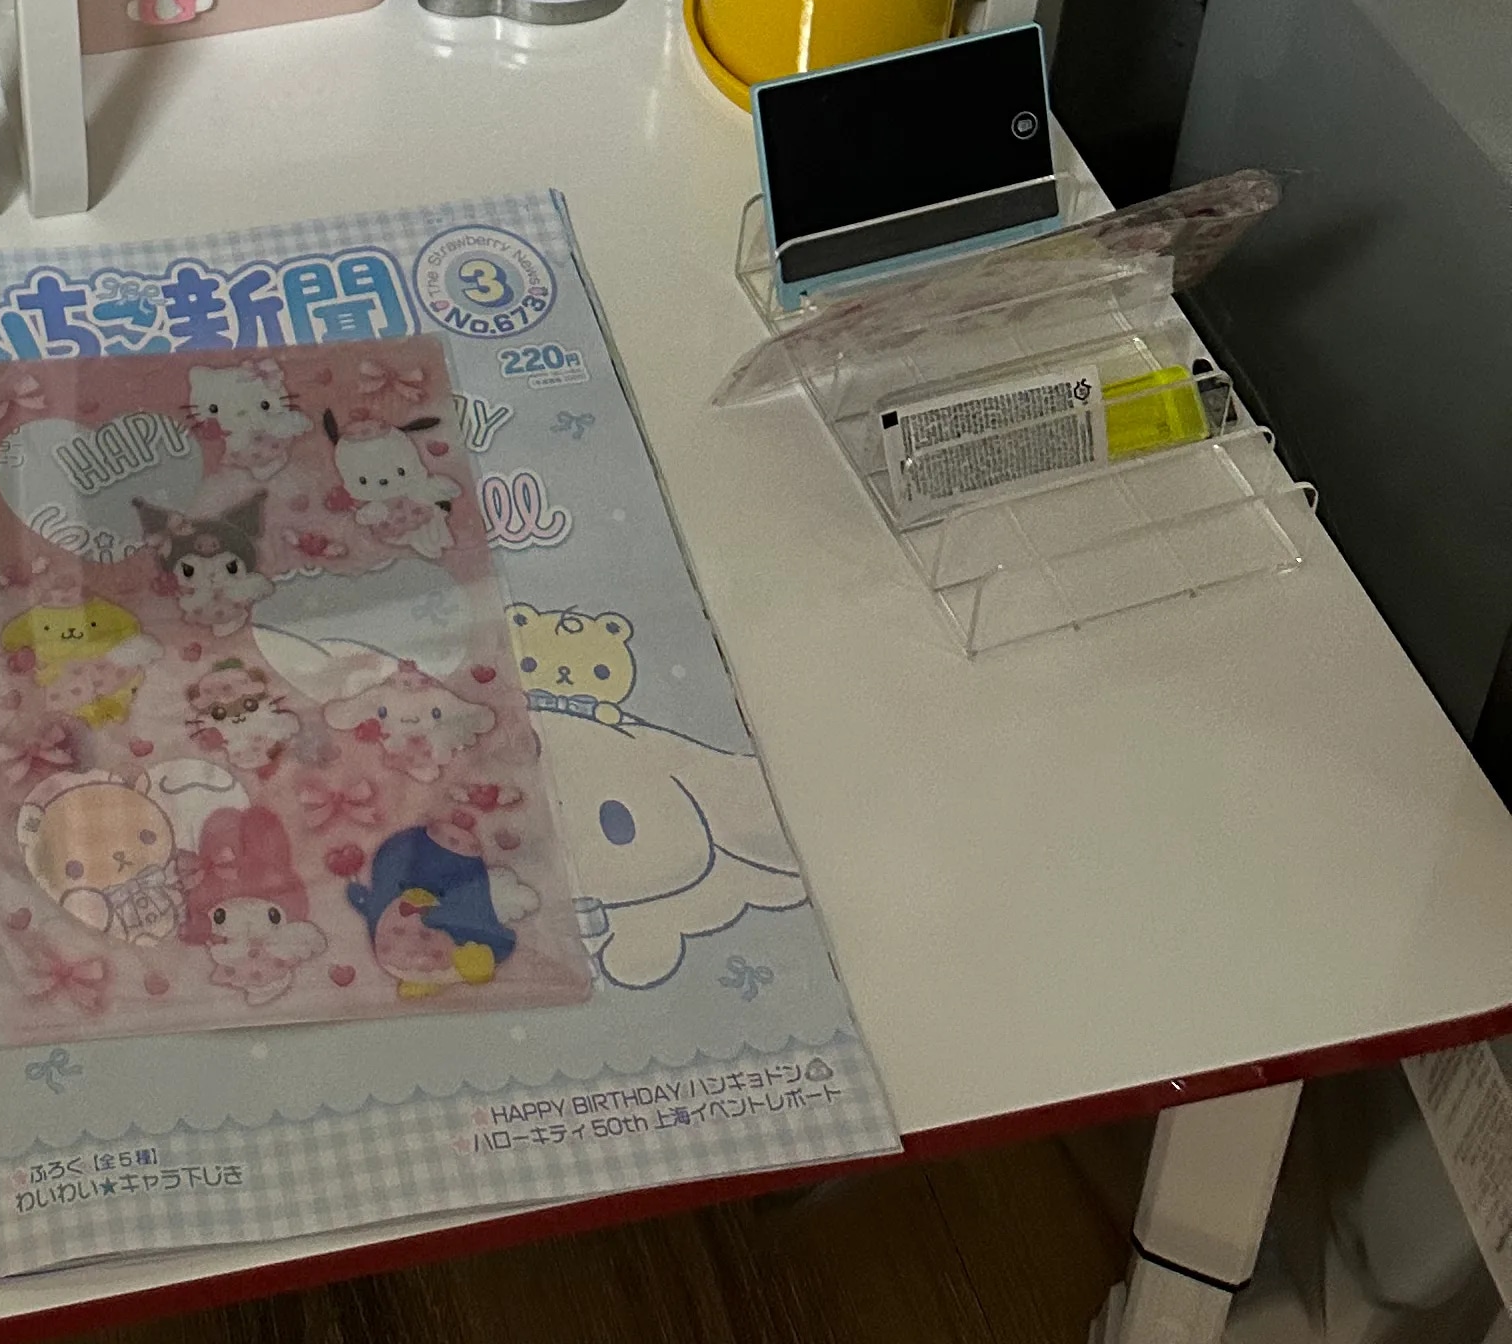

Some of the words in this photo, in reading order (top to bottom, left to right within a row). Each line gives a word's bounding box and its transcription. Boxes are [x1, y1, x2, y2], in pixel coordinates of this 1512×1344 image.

[428, 234, 512, 267] Strawberry
[512, 248, 541, 289] News
[458, 258, 515, 308] 3
[444, 294, 547, 335] No.673
[499, 344, 581, 375] 220円
[491, 1098, 565, 1126] HAPPY
[572, 1081, 682, 1116] BIRTHDAY
[688, 1063, 801, 1099] ハンギョドン
[474, 1122, 586, 1153] ハローキティ
[592, 1115, 649, 1138] 50th
[29, 1157, 85, 1185] ふろく
